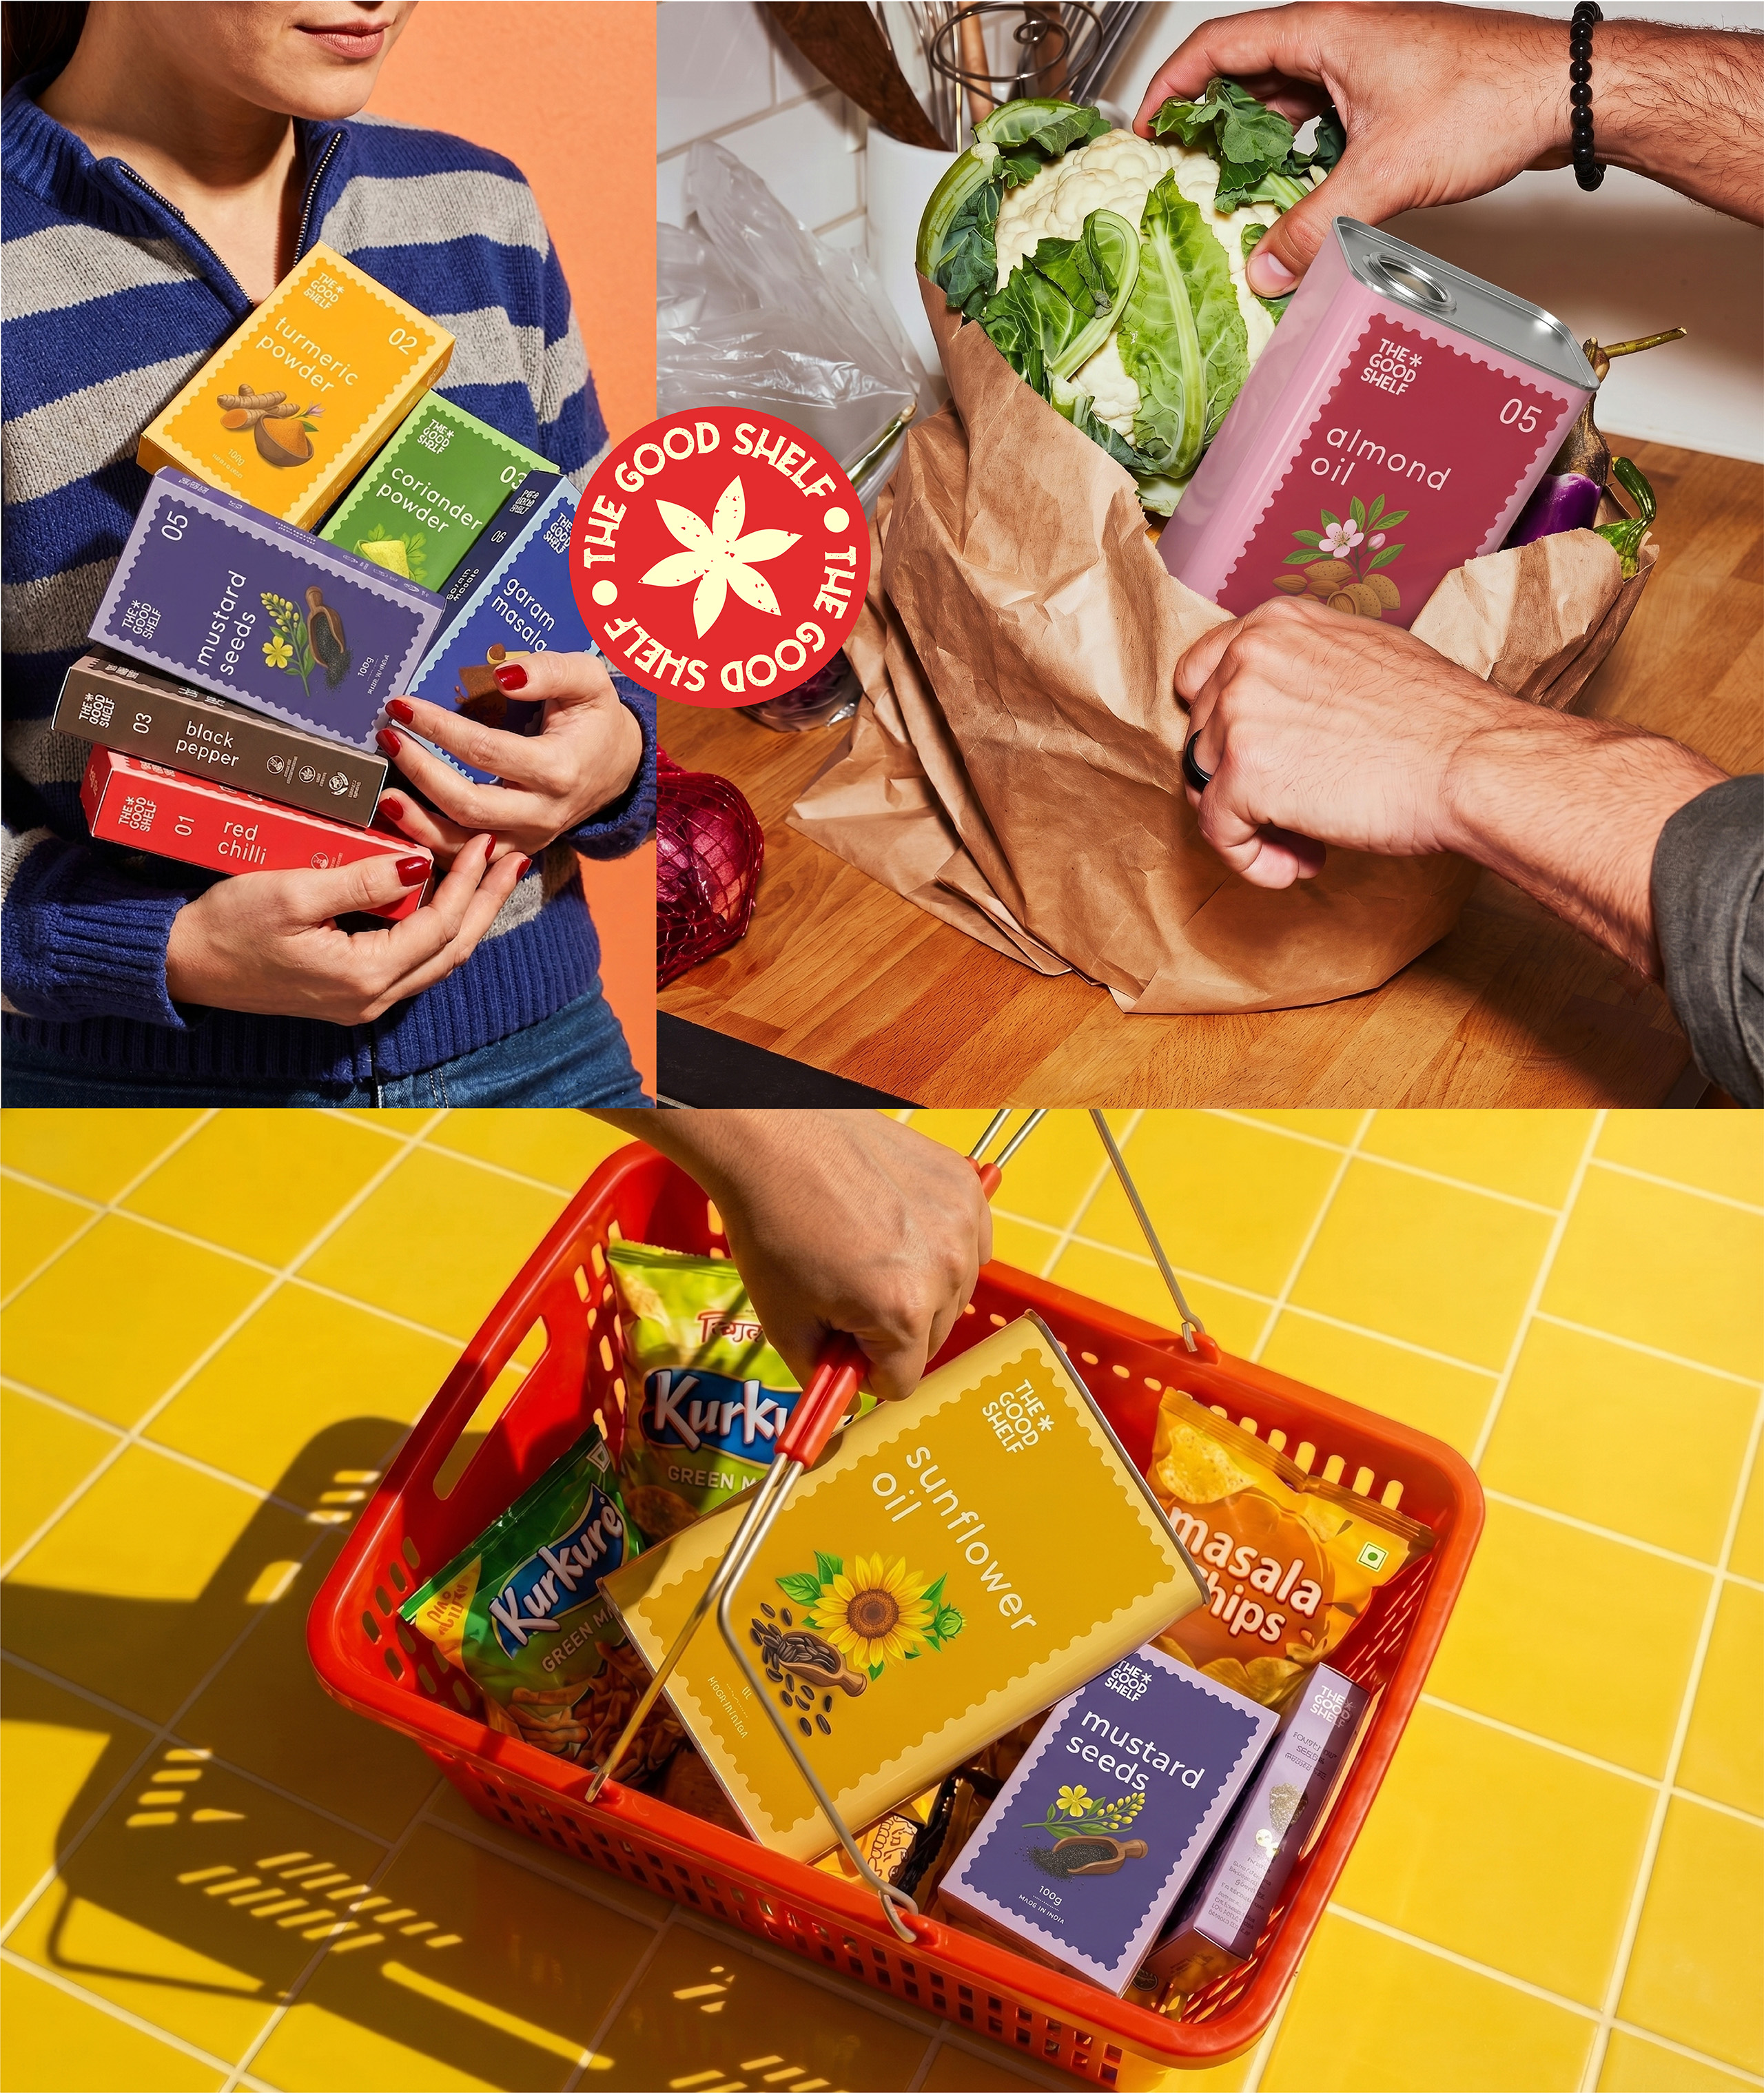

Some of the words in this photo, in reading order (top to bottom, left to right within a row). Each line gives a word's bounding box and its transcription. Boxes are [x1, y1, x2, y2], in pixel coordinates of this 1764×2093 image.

[311, 280, 338, 303] GOOD
[274, 316, 358, 386] turmeric
[389, 328, 418, 355] 02
[1380, 338, 1411, 363] THE
[256, 334, 334, 392] powder
[1369, 354, 1416, 383] GOOD
[1361, 367, 1408, 396] SHELF
[1499, 398, 1542, 433] 05
[423, 427, 449, 447] GOOD
[1311, 457, 1355, 486] oil
[1326, 427, 1452, 491] almond
[376, 483, 449, 533] powder
[391, 467, 482, 530] coriander
[161, 510, 189, 541] 05
[551, 522, 571, 547] GOOD
[132, 603, 152, 634] GOOD
[196, 569, 247, 667] mustard
[502, 578, 555, 632] garam
[142, 608, 161, 640] SHELF
[491, 595, 548, 652] masala
[219, 611, 256, 676] seeds
[358, 657, 374, 677] 100g
[89, 694, 105, 725] GOOD
[132, 713, 152, 735] 03
[185, 720, 234, 749] black
[175, 737, 240, 768] pepper
[118, 805, 133, 824] THE
[129, 797, 147, 830] GOOD
[139, 800, 157, 833] SHELF
[174, 815, 195, 836] 01
[223, 820, 258, 841] red
[218, 841, 267, 866] chilli
[1015, 1378, 1045, 1417] THE
[982, 1401, 1025, 1453] SHELF
[998, 1391, 1039, 1447] GOOD
[668, 1465, 735, 1489] GREEN
[872, 1472, 922, 1522] oil
[905, 1447, 1038, 1630] sunflower
[489, 1505, 624, 1647] Kurkure
[1169, 1506, 1322, 1619] masala
[542, 1622, 593, 1673] GREEN
[1111, 1668, 1147, 1694] GOOD
[1118, 1660, 1143, 1679] THE
[1104, 1677, 1142, 1702] SHELF
[1321, 1685, 1346, 1706] THE
[1310, 1704, 1346, 1728] SHELF
[1314, 1695, 1351, 1720] GOOD
[1065, 1734, 1151, 1791] seeds
[1080, 1710, 1206, 1790] mustard
[1038, 1906, 1047, 1914] IN
[1039, 1885, 1063, 1906] 100g
